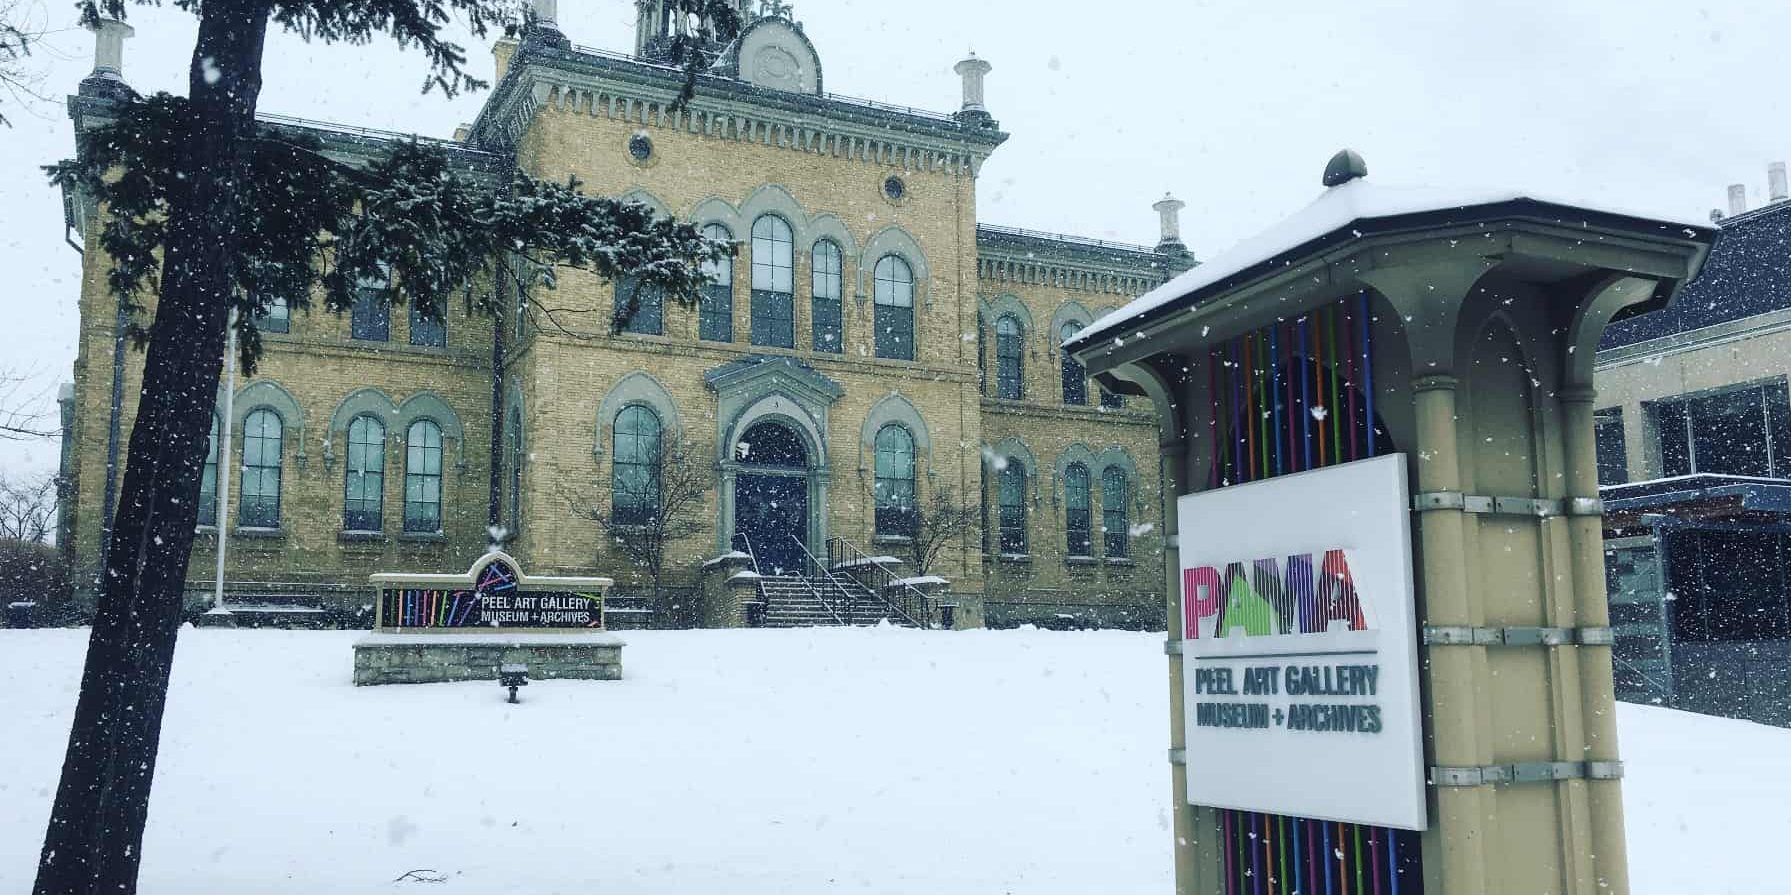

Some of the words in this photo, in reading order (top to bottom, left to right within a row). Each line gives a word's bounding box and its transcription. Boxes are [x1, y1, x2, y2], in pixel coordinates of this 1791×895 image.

[481, 596, 511, 609] PEEL
[514, 597, 537, 609] ART
[540, 597, 590, 610] GALLERY
[1184, 549, 1368, 640] PAMA
[481, 611, 529, 622] MUSEUM
[540, 611, 590, 623] ARCHIVES
[1195, 667, 1238, 695] PEEL
[1243, 666, 1281, 695] ART
[1285, 664, 1379, 696] GALLERY
[1197, 702, 1269, 729] MUSEUM
[1272, 708, 1284, 726] +
[1287, 703, 1382, 734] ARCHIVES
